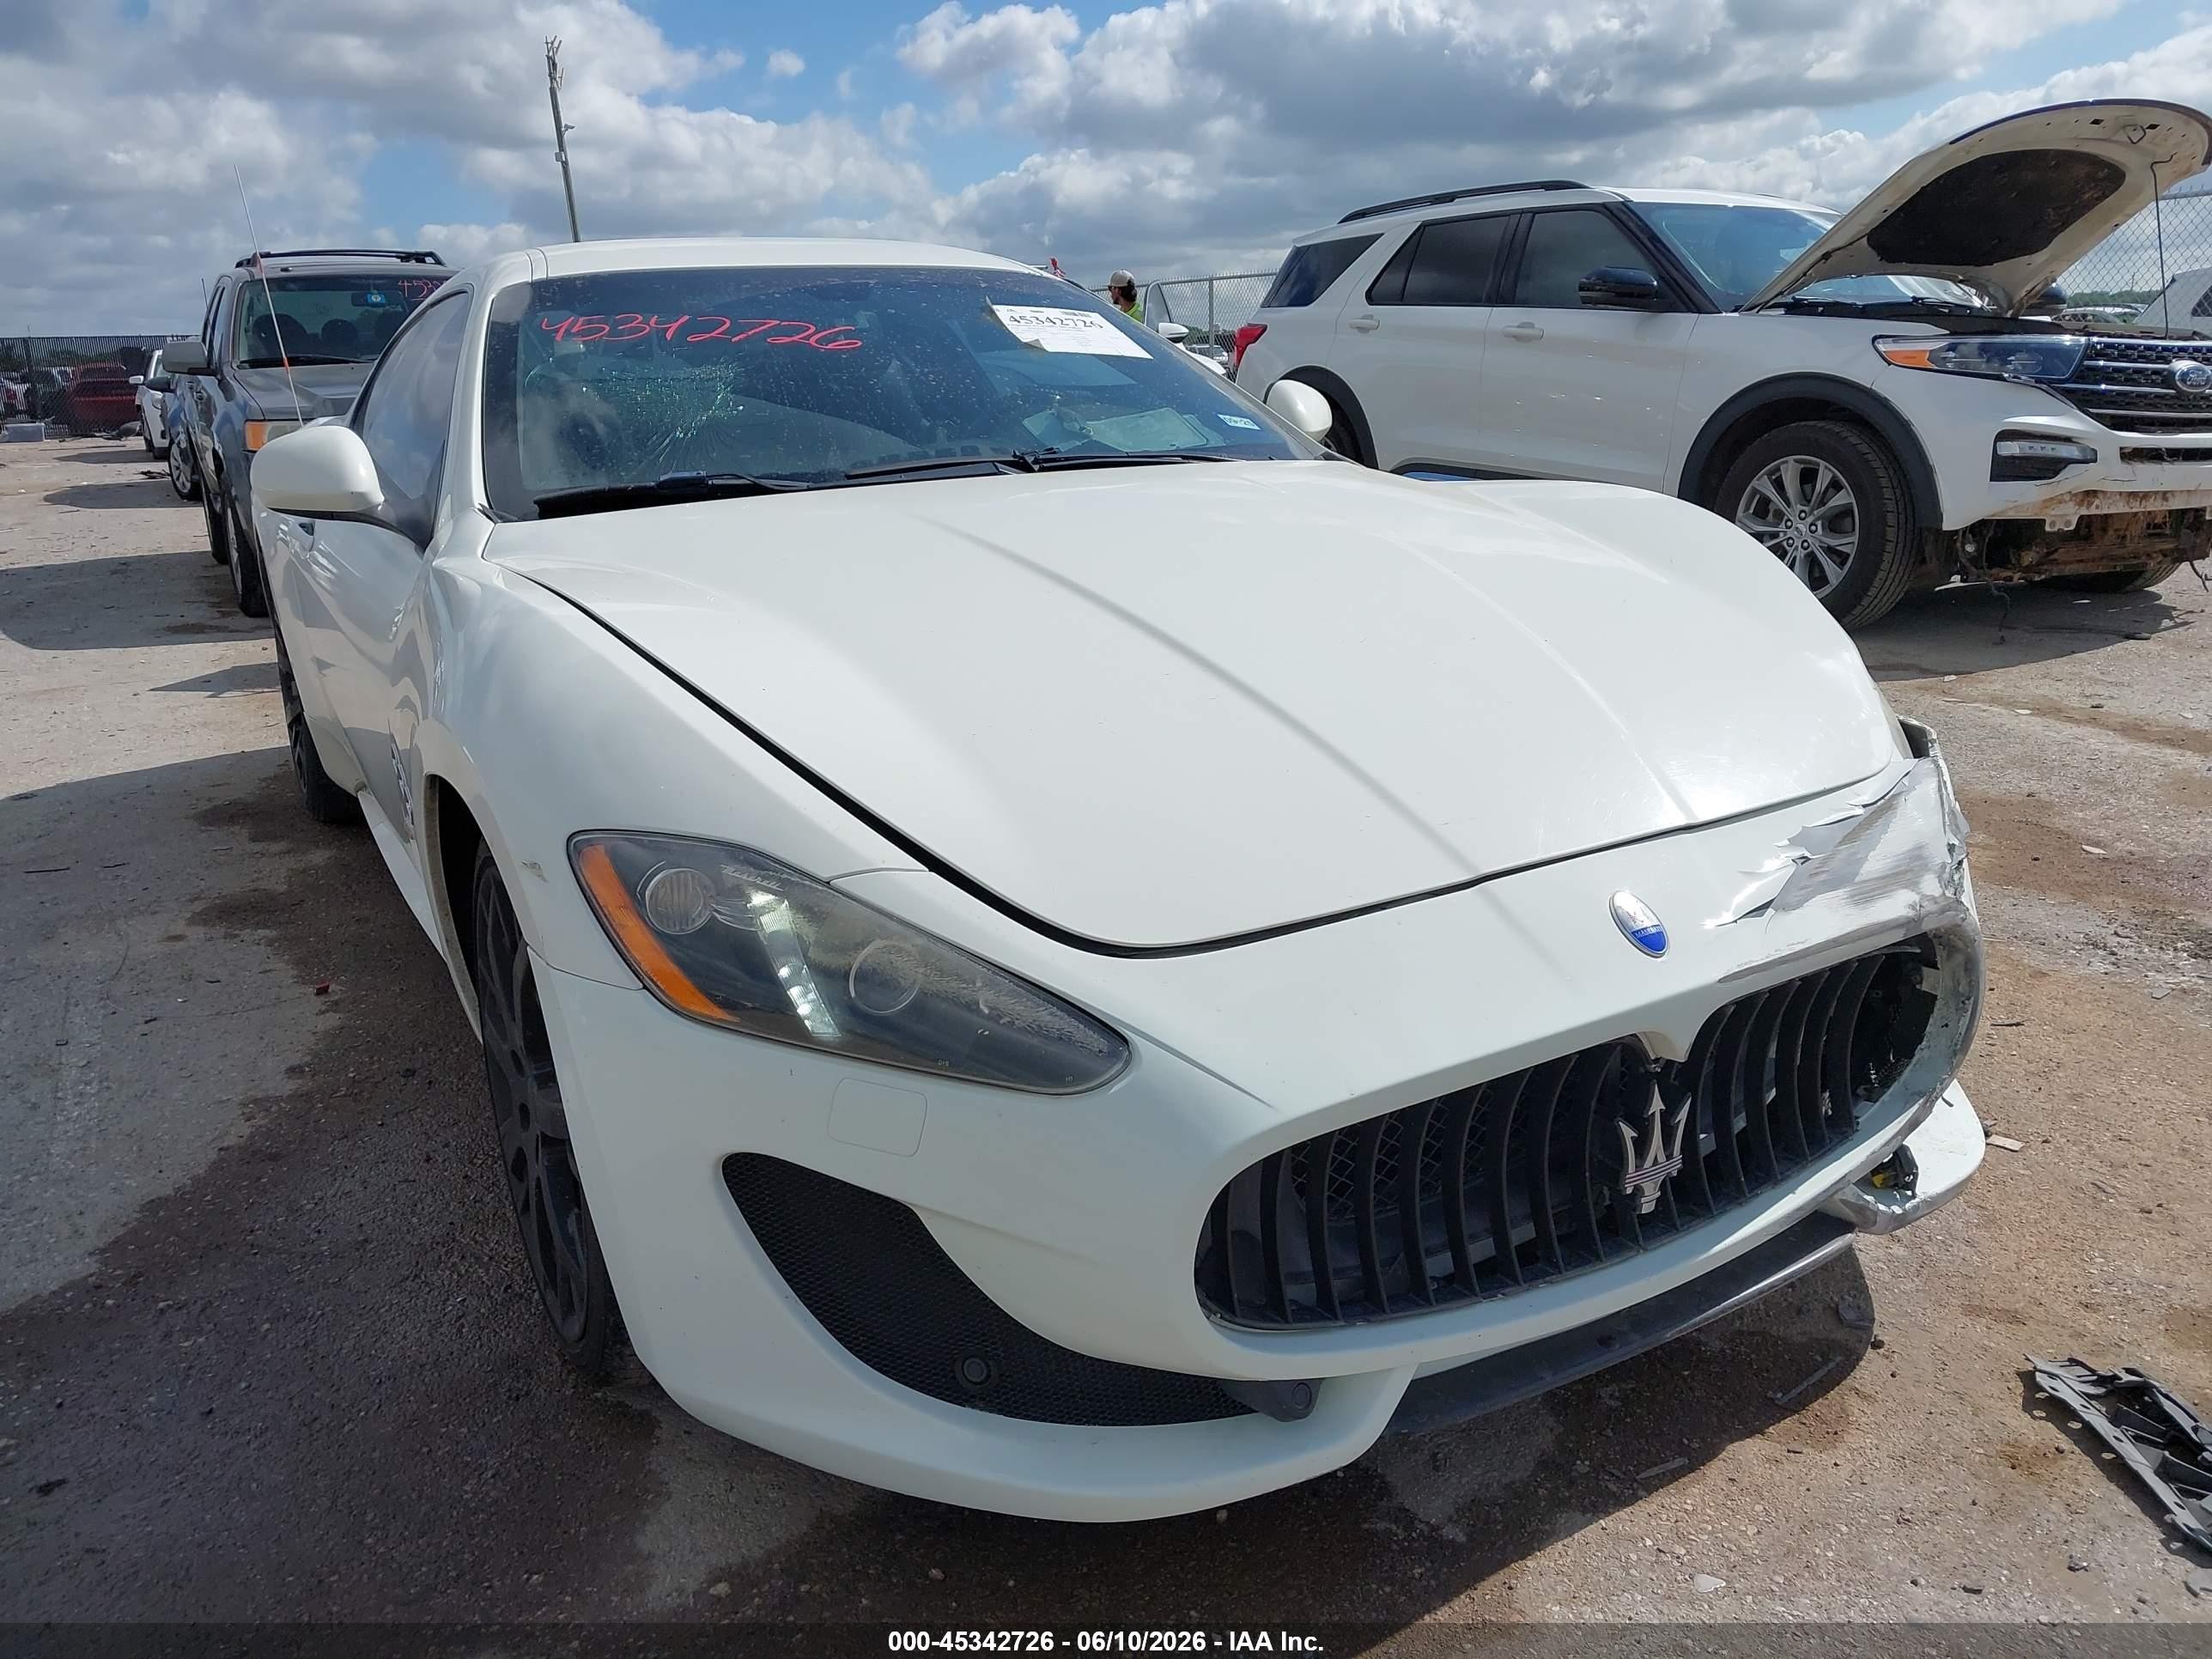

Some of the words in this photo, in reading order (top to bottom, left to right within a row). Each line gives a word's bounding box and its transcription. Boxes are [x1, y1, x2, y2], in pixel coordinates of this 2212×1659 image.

[1008, 314, 1104, 329] 45342726
[541, 313, 862, 350] 45342726
[2185, 369, 2208, 386] Ford
